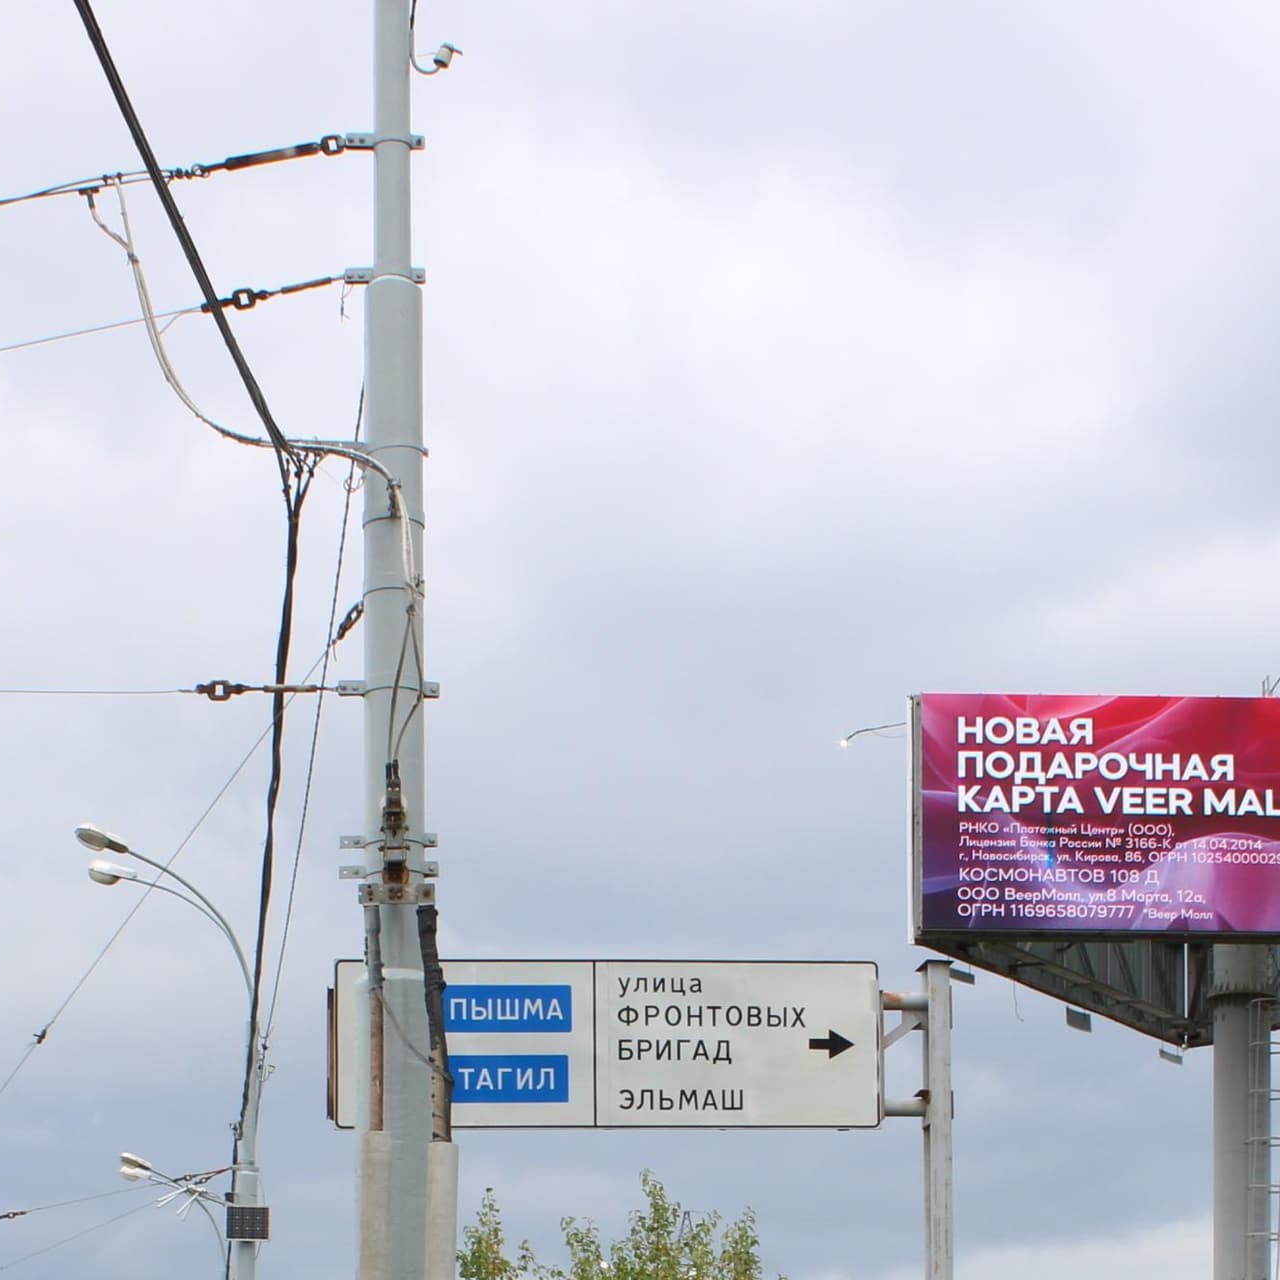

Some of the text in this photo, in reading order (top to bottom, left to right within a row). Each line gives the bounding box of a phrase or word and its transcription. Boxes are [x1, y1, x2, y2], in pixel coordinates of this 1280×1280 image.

[957, 716, 1093, 745] НОВАЯ
[957, 750, 1235, 784] ПОДАРОЧНАЯ
[957, 785, 1084, 813] КАРТА
[1094, 787, 1193, 815] VEER
[959, 822, 1175, 836] РНКО «Платежный Центр» (ООО),
[959, 836, 1263, 850] Лицензия Банка России № 3166-К от 14.04.2014
[972, 850, 1053, 864] Новосибирск,
[1056, 854, 1071, 864] ул.
[1075, 851, 1122, 864] Кирова,
[1124, 852, 1145, 863] 86,
[1148, 852, 1187, 863] ОГРН
[959, 868, 1160, 885] КОСМОНАВТОВ 108 Д
[957, 887, 1000, 901] ООО
[1121, 889, 1173, 905] Марта,
[1177, 890, 1207, 904] 12а,
[957, 903, 1005, 917] ОГРН
[1010, 904, 1135, 919] 1169658079777
[1181, 908, 1214, 920] Молл
[618, 977, 702, 997] улица
[450, 998, 564, 1020] ПЫШМА
[617, 1005, 806, 1028] ФРОНТОВЫХ
[618, 1039, 733, 1064] БРИГАД
[458, 1067, 555, 1090] ТАГИЛ
[618, 1089, 743, 1110] ЭЛЬМАШ
